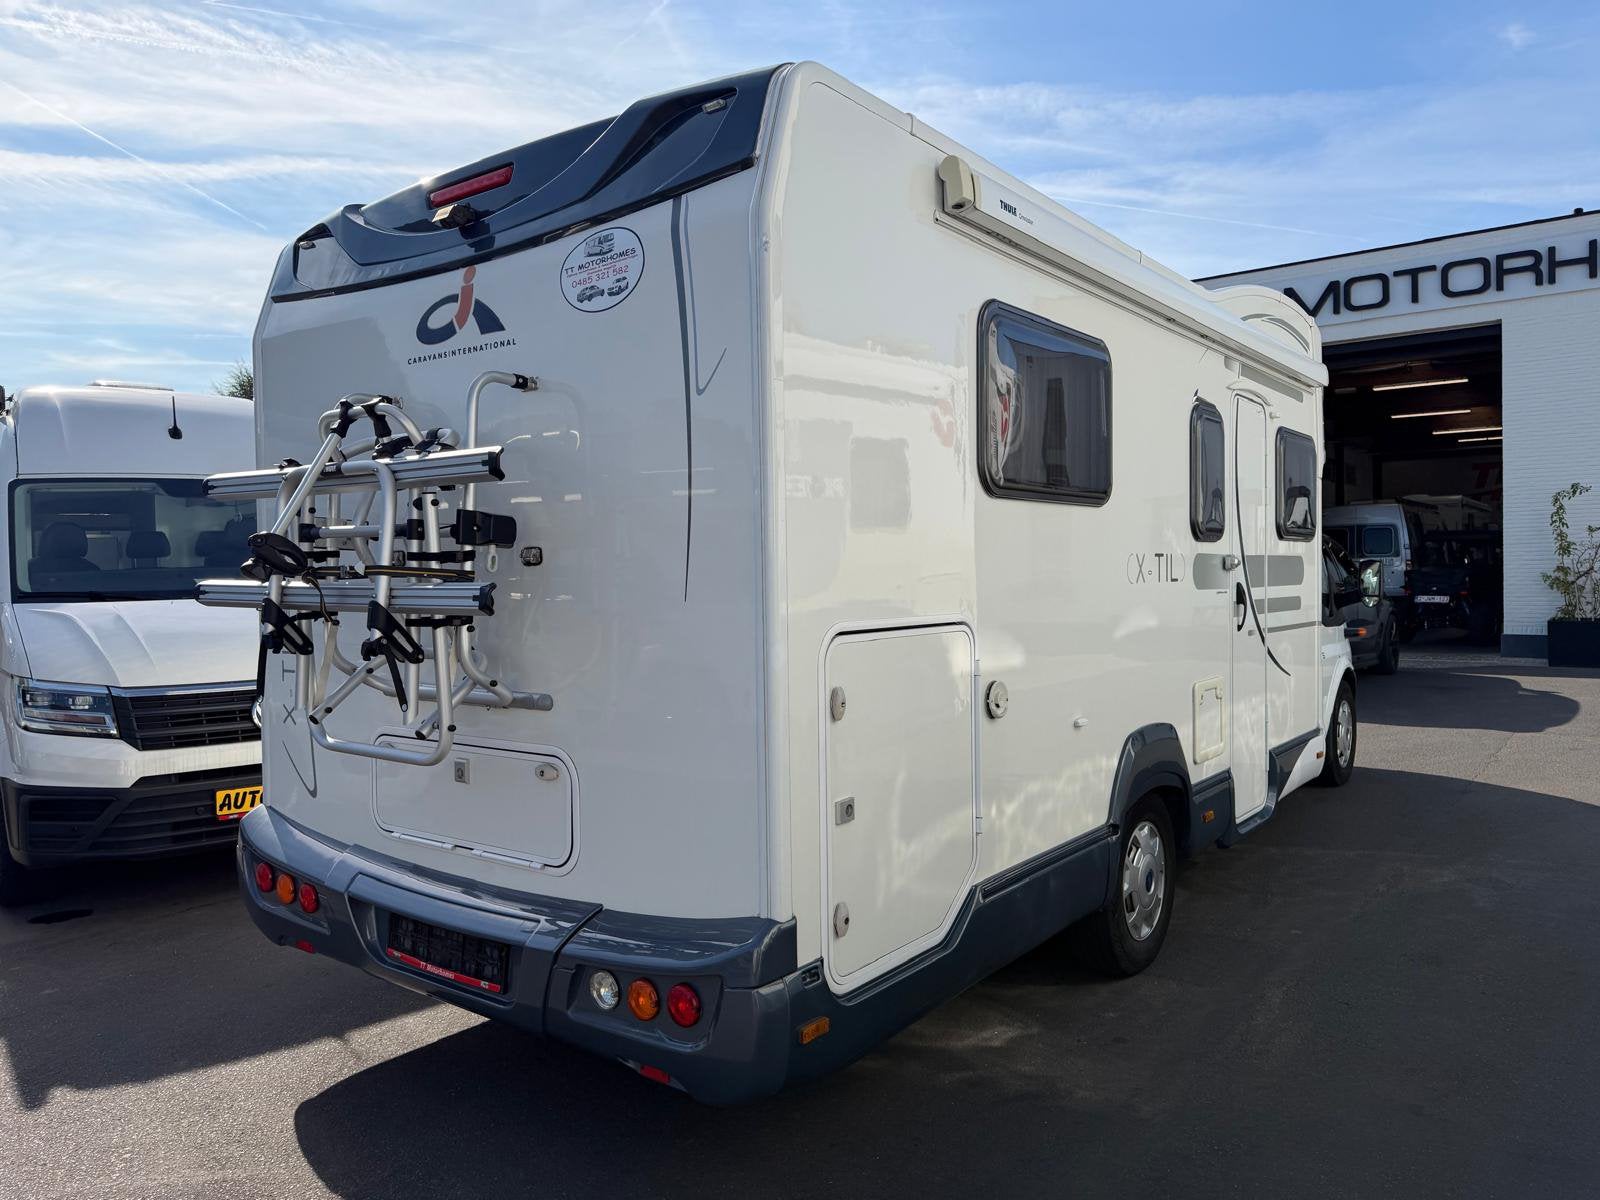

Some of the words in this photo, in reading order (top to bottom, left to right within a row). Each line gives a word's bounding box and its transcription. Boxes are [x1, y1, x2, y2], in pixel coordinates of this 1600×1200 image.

[1000, 200, 1017, 216] THULE
[564, 266, 575, 275] TT
[577, 247, 637, 271] MOTORHOMES
[571, 275, 593, 288] 0485
[595, 271, 610, 281] 321
[612, 265, 629, 276] 582
[219, 790, 263, 812] AUT
